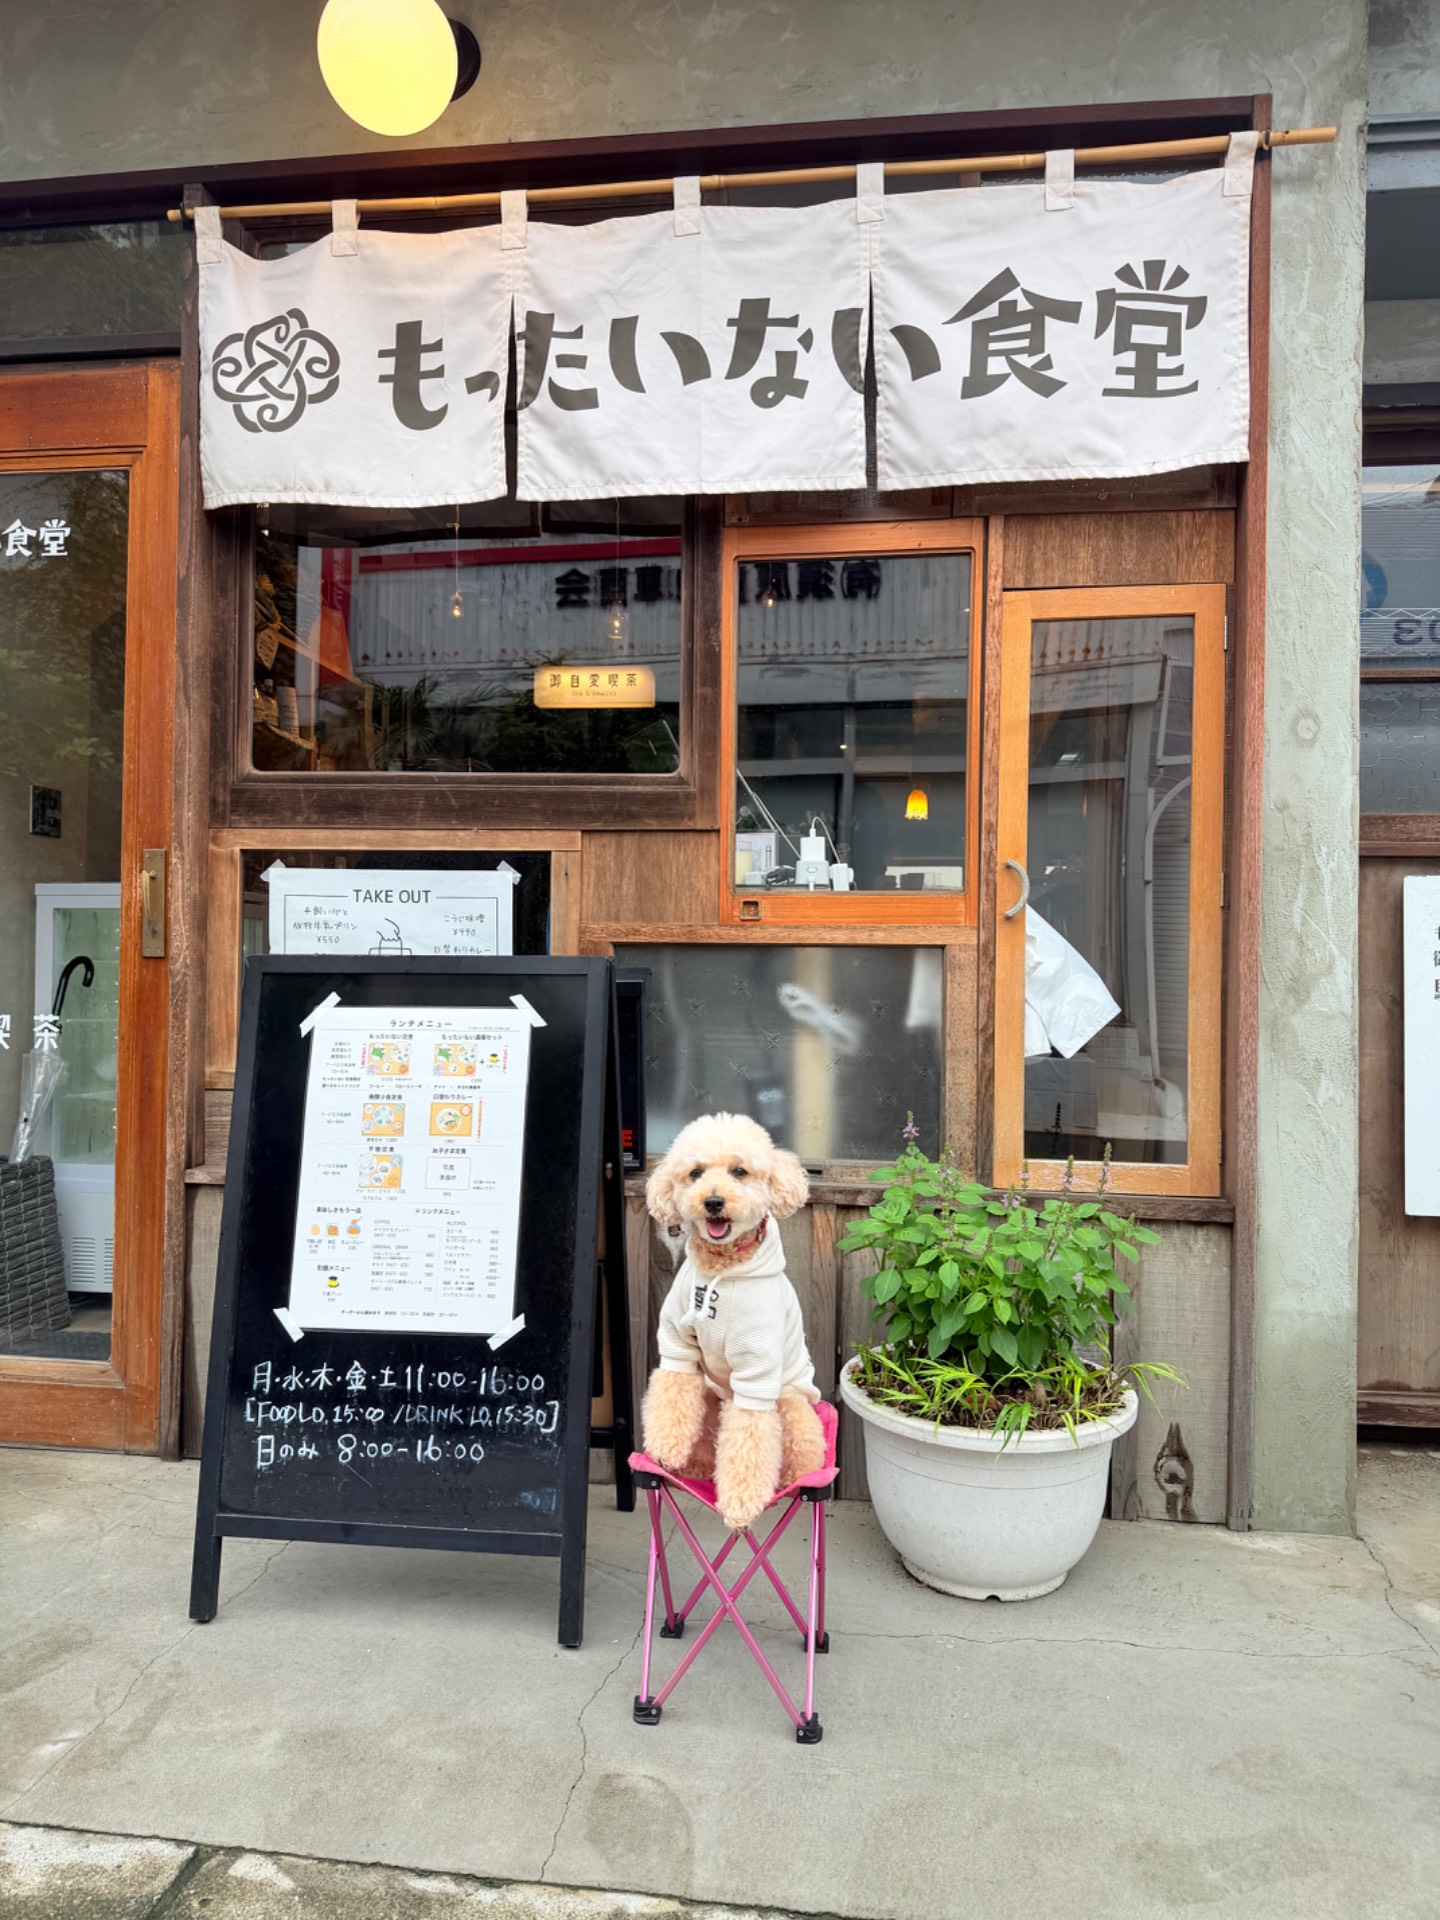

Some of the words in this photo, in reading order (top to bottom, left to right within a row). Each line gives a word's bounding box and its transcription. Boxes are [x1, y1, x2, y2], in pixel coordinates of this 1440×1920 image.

[378, 259, 1207, 430] もったいない食堂
[1, 518, 71, 557] 食堂
[353, 889, 394, 904] TAKE
[398, 890, 432, 904] OUT
[389, 1019, 453, 1029] ランチメニュー
[257, 1434, 320, 1470] 日のみ
[337, 1433, 486, 1464] 8:00-16:00
